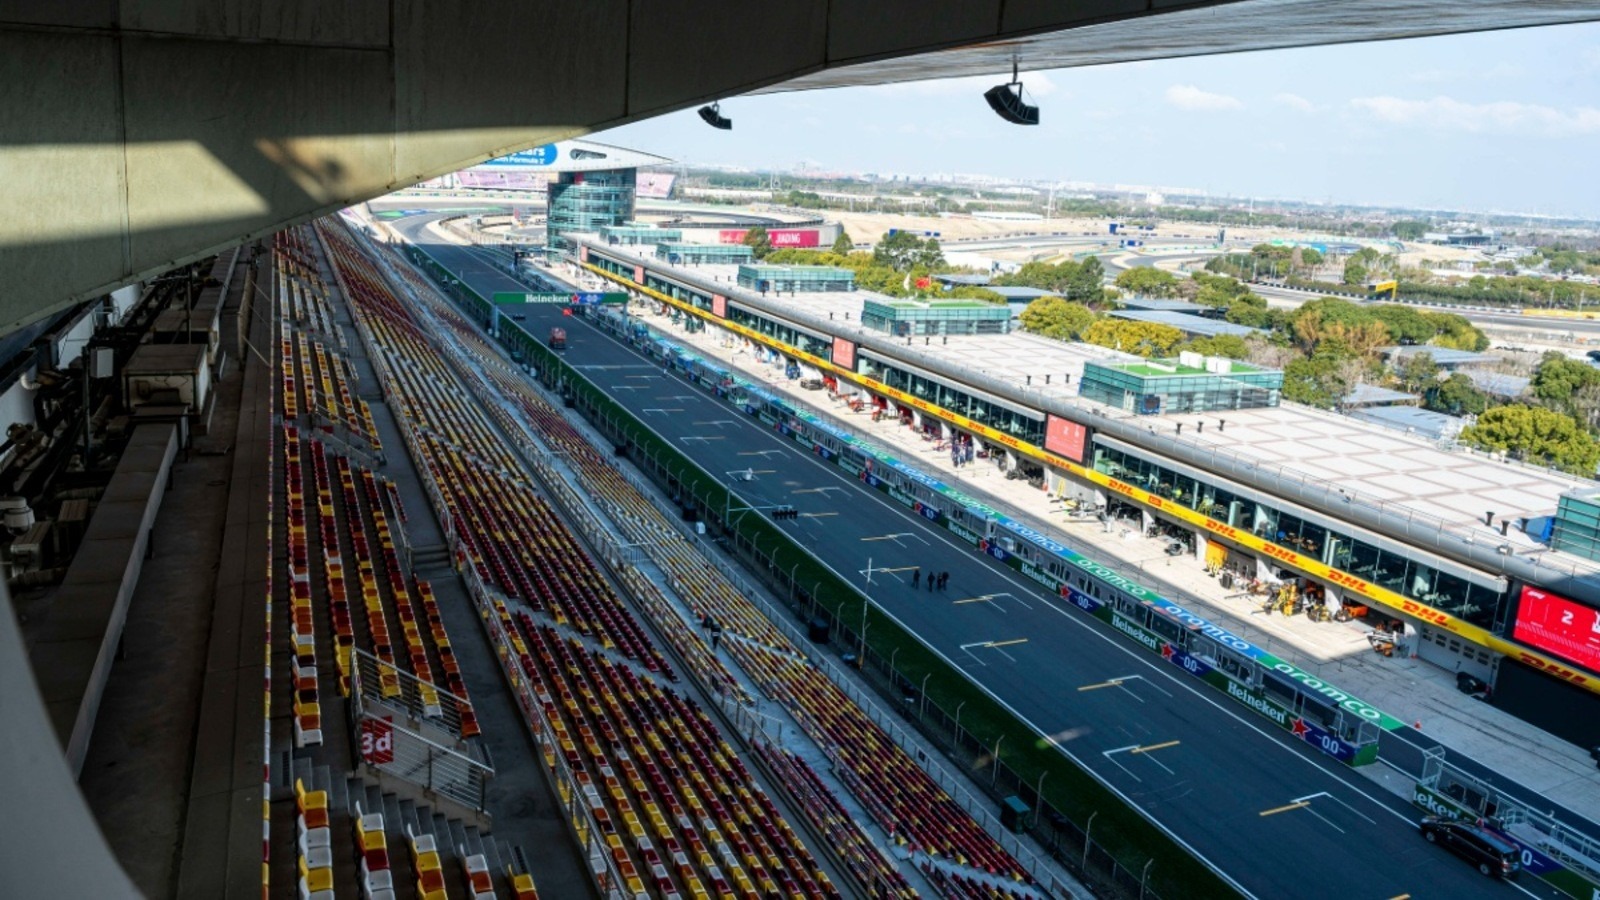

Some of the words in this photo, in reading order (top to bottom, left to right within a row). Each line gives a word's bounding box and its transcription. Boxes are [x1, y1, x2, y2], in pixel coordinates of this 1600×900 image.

[525, 294, 569, 303] Heineken
[888, 388, 902, 398] DHL
[913, 398, 927, 409] DHL
[939, 409, 955, 421] DHL
[968, 421, 986, 433] DHL
[999, 434, 1018, 448] DHL
[1108, 479, 1134, 496] DHL
[1005, 521, 1064, 552] aramco
[1205, 519, 1237, 539] DHL
[1262, 543, 1298, 564] DHL
[1021, 562, 1057, 590] Heineken
[1077, 559, 1147, 596] aramco
[1327, 569, 1369, 593] DHL
[1401, 600, 1449, 627] DHL
[1560, 609, 1575, 626] 2
[1111, 614, 1157, 650] Heineken
[1165, 604, 1251, 651] aramco
[1274, 662, 1381, 720] aramco
[1227, 681, 1287, 724] Heineken
[362, 731, 391, 754] 3d
